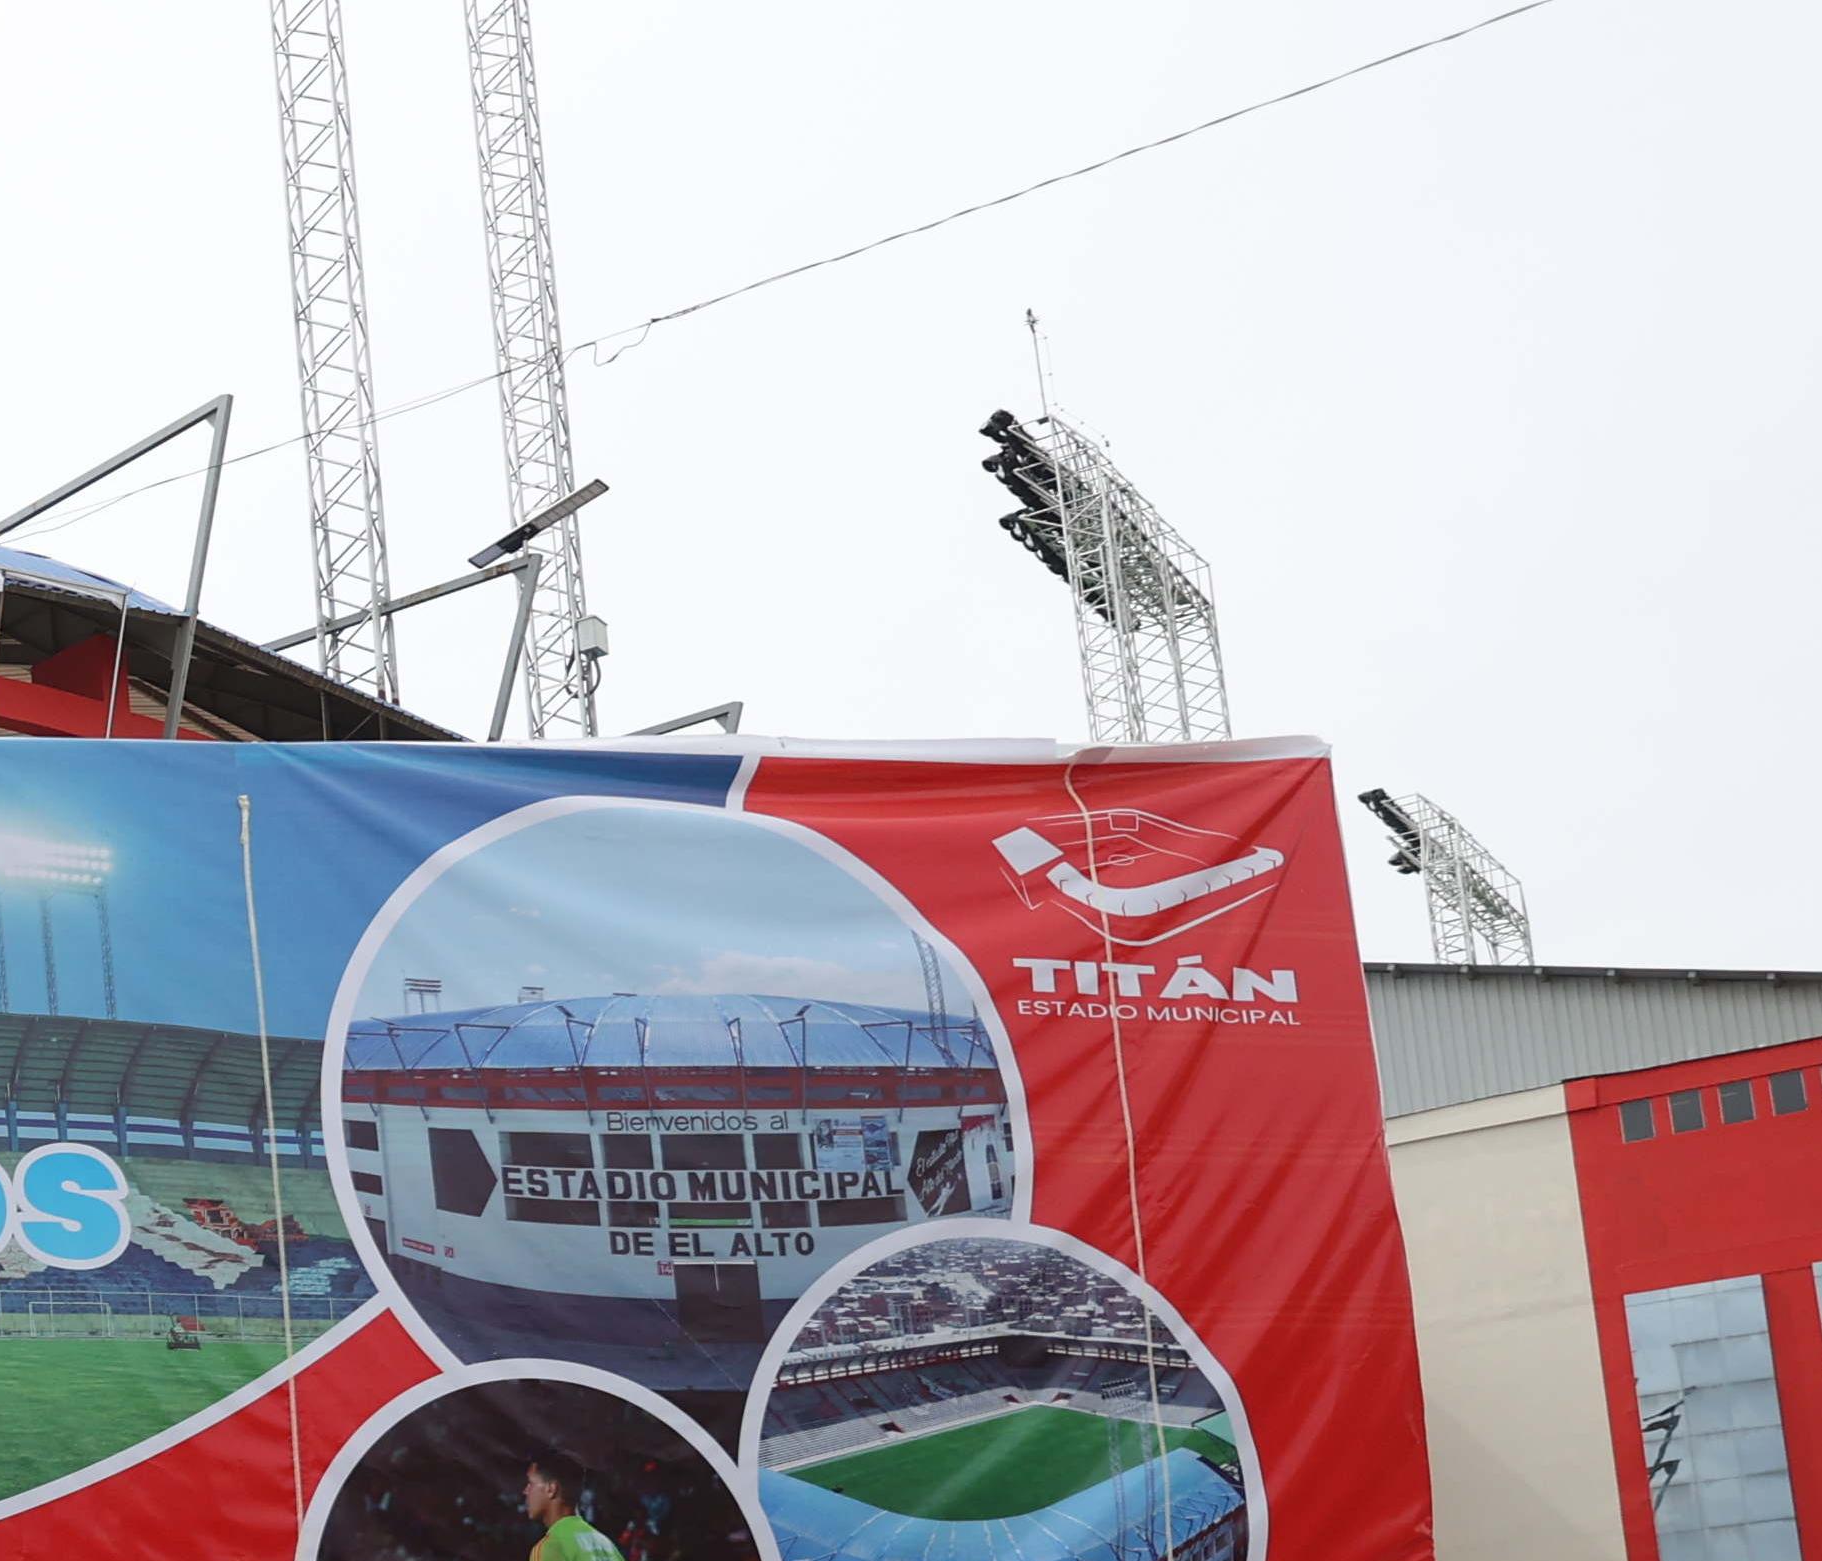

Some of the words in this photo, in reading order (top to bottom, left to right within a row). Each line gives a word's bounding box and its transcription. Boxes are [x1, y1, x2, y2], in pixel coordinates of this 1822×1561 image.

[1012, 954, 1299, 1003] TITÁN
[1017, 1000, 1138, 1020] ESTADIO
[1147, 1005, 1302, 1026] MUNICIPAL
[606, 1111, 757, 1132] Bienvenidos
[770, 1111, 789, 1130] al
[500, 1166, 677, 1201] ESTADIO
[688, 1169, 905, 1202] MUNICIPAL
[610, 1231, 653, 1256] DE
[668, 1233, 715, 1257] EL
[730, 1231, 815, 1257] ALTO
